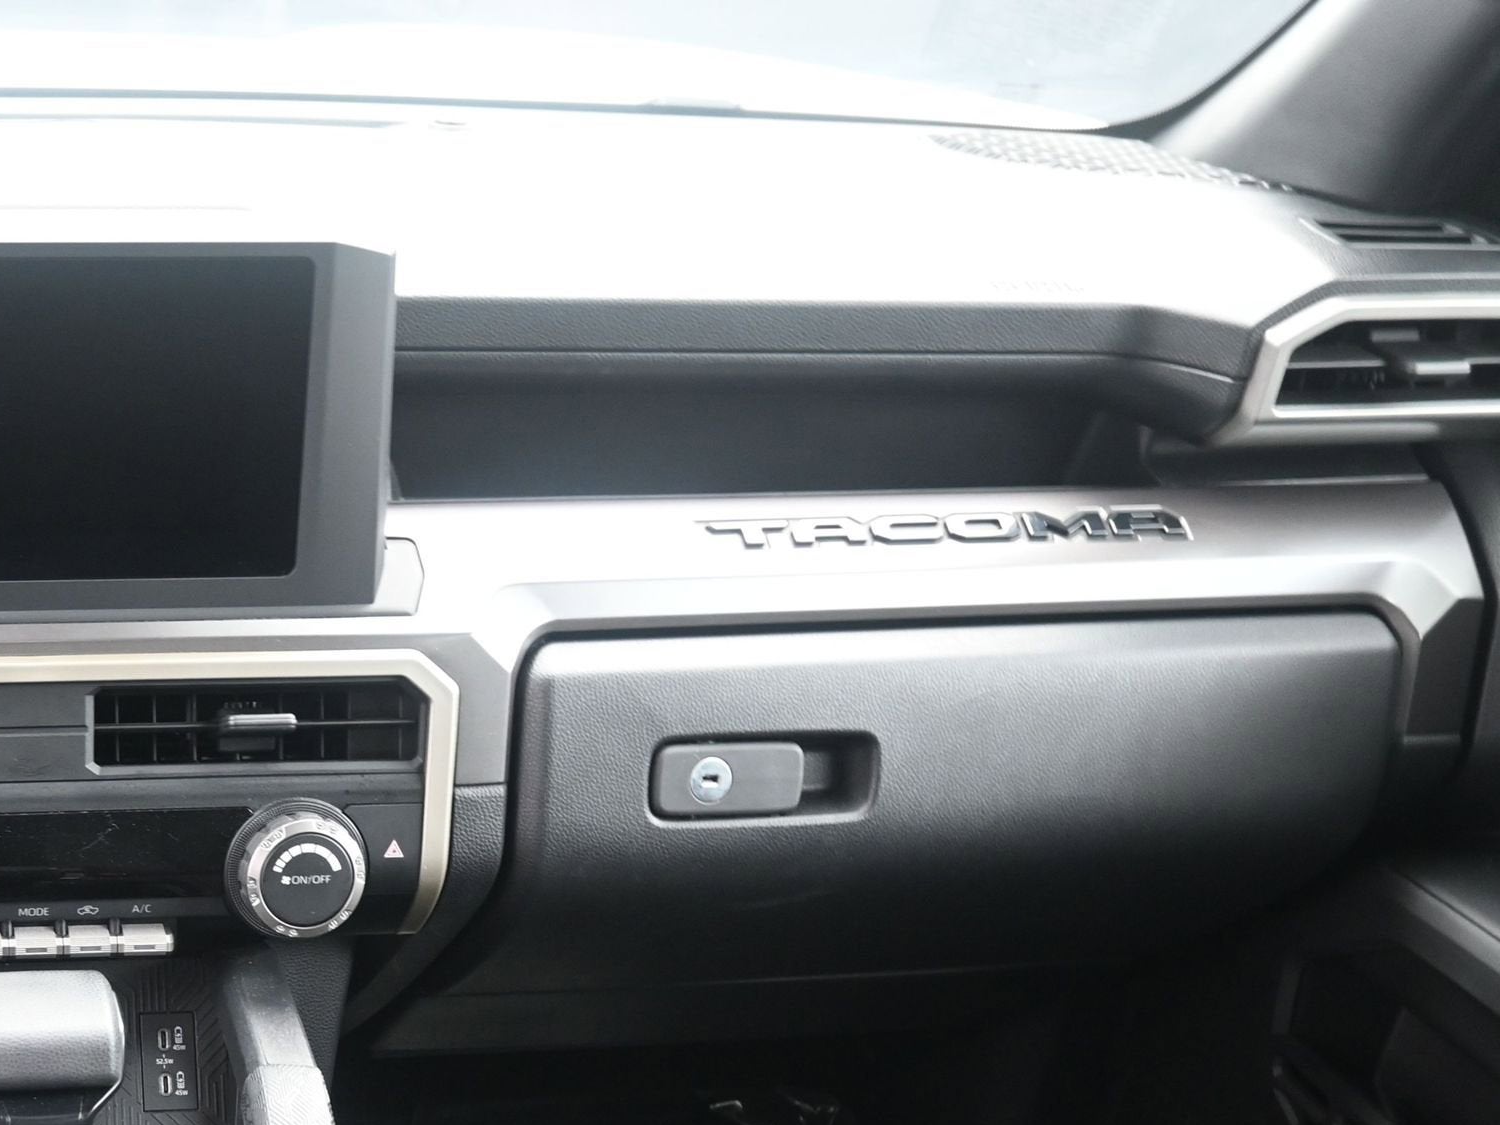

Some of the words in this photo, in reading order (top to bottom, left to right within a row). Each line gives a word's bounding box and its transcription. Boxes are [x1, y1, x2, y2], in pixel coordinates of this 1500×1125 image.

[700, 504, 1194, 549] TACOMA
[291, 875, 332, 885] ON/OFF
[18, 907, 50, 917] MODE
[131, 904, 152, 914] A/C
